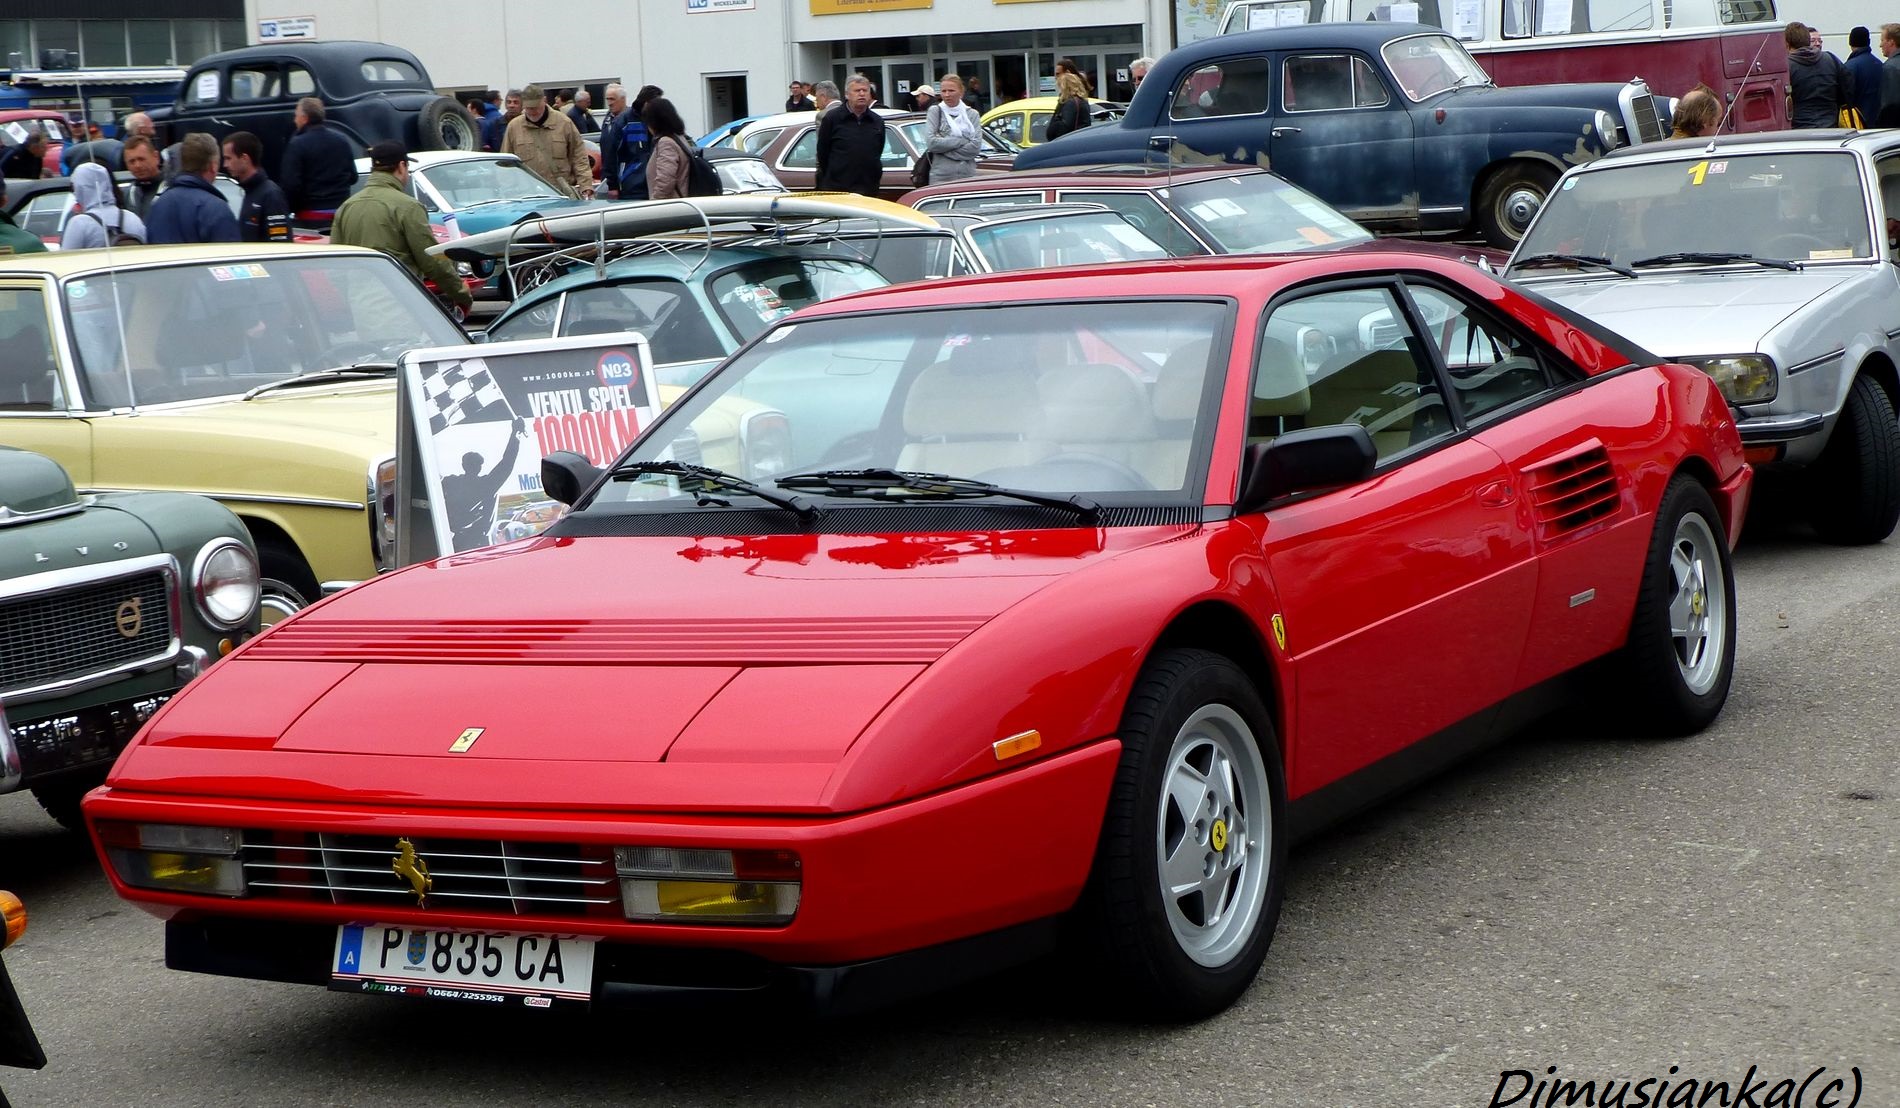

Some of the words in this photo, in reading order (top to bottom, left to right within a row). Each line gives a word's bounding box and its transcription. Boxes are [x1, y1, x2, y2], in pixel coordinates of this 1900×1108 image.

[1688, 161, 1709, 185] 1
[522, 369, 595, 382] www.1000km.at
[527, 388, 588, 417] VENTIL
[588, 385, 635, 412] SPIEL
[533, 408, 640, 466] 1000KM
[344, 951, 355, 965] A
[380, 928, 404, 969] P
[431, 932, 502, 977] 835
[514, 937, 565, 983] CA
[433, 989, 505, 1002] 0664/3255956
